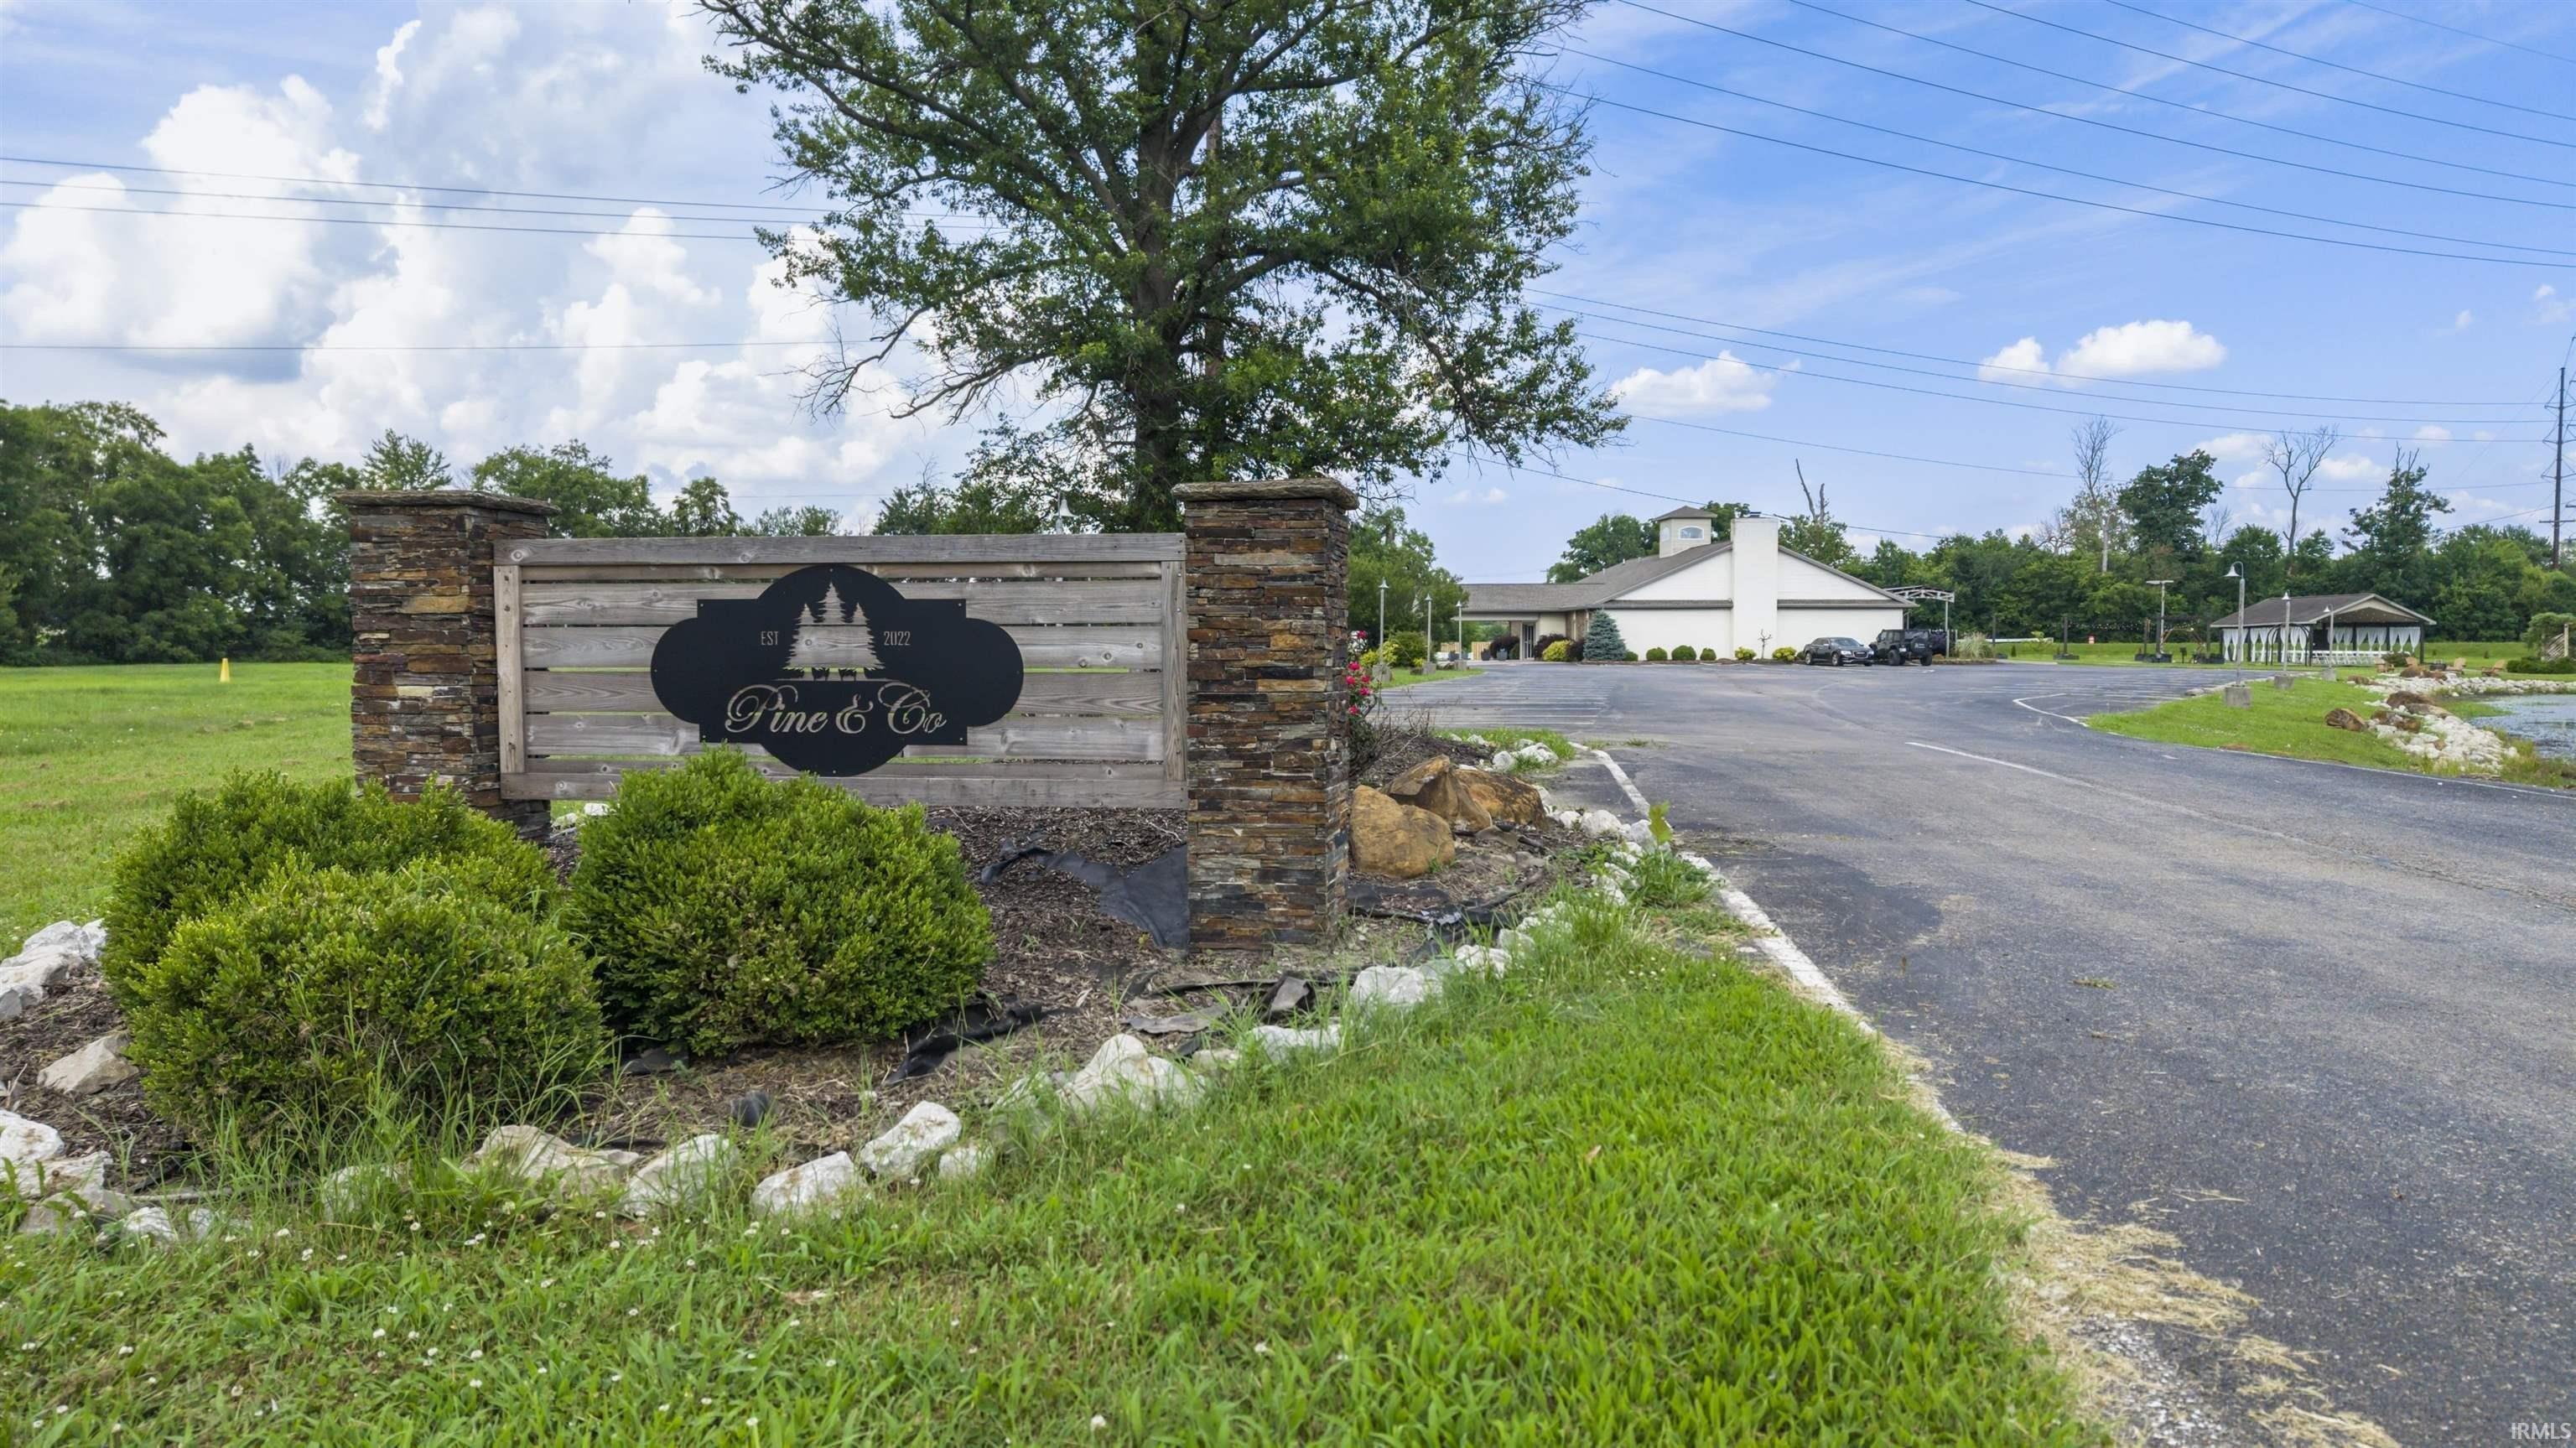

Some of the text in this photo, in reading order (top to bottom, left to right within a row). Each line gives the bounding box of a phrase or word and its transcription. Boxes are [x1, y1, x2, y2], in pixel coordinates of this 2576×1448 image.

[761, 631, 911, 646] EST 2022
[725, 682, 947, 734] Pine & Co
